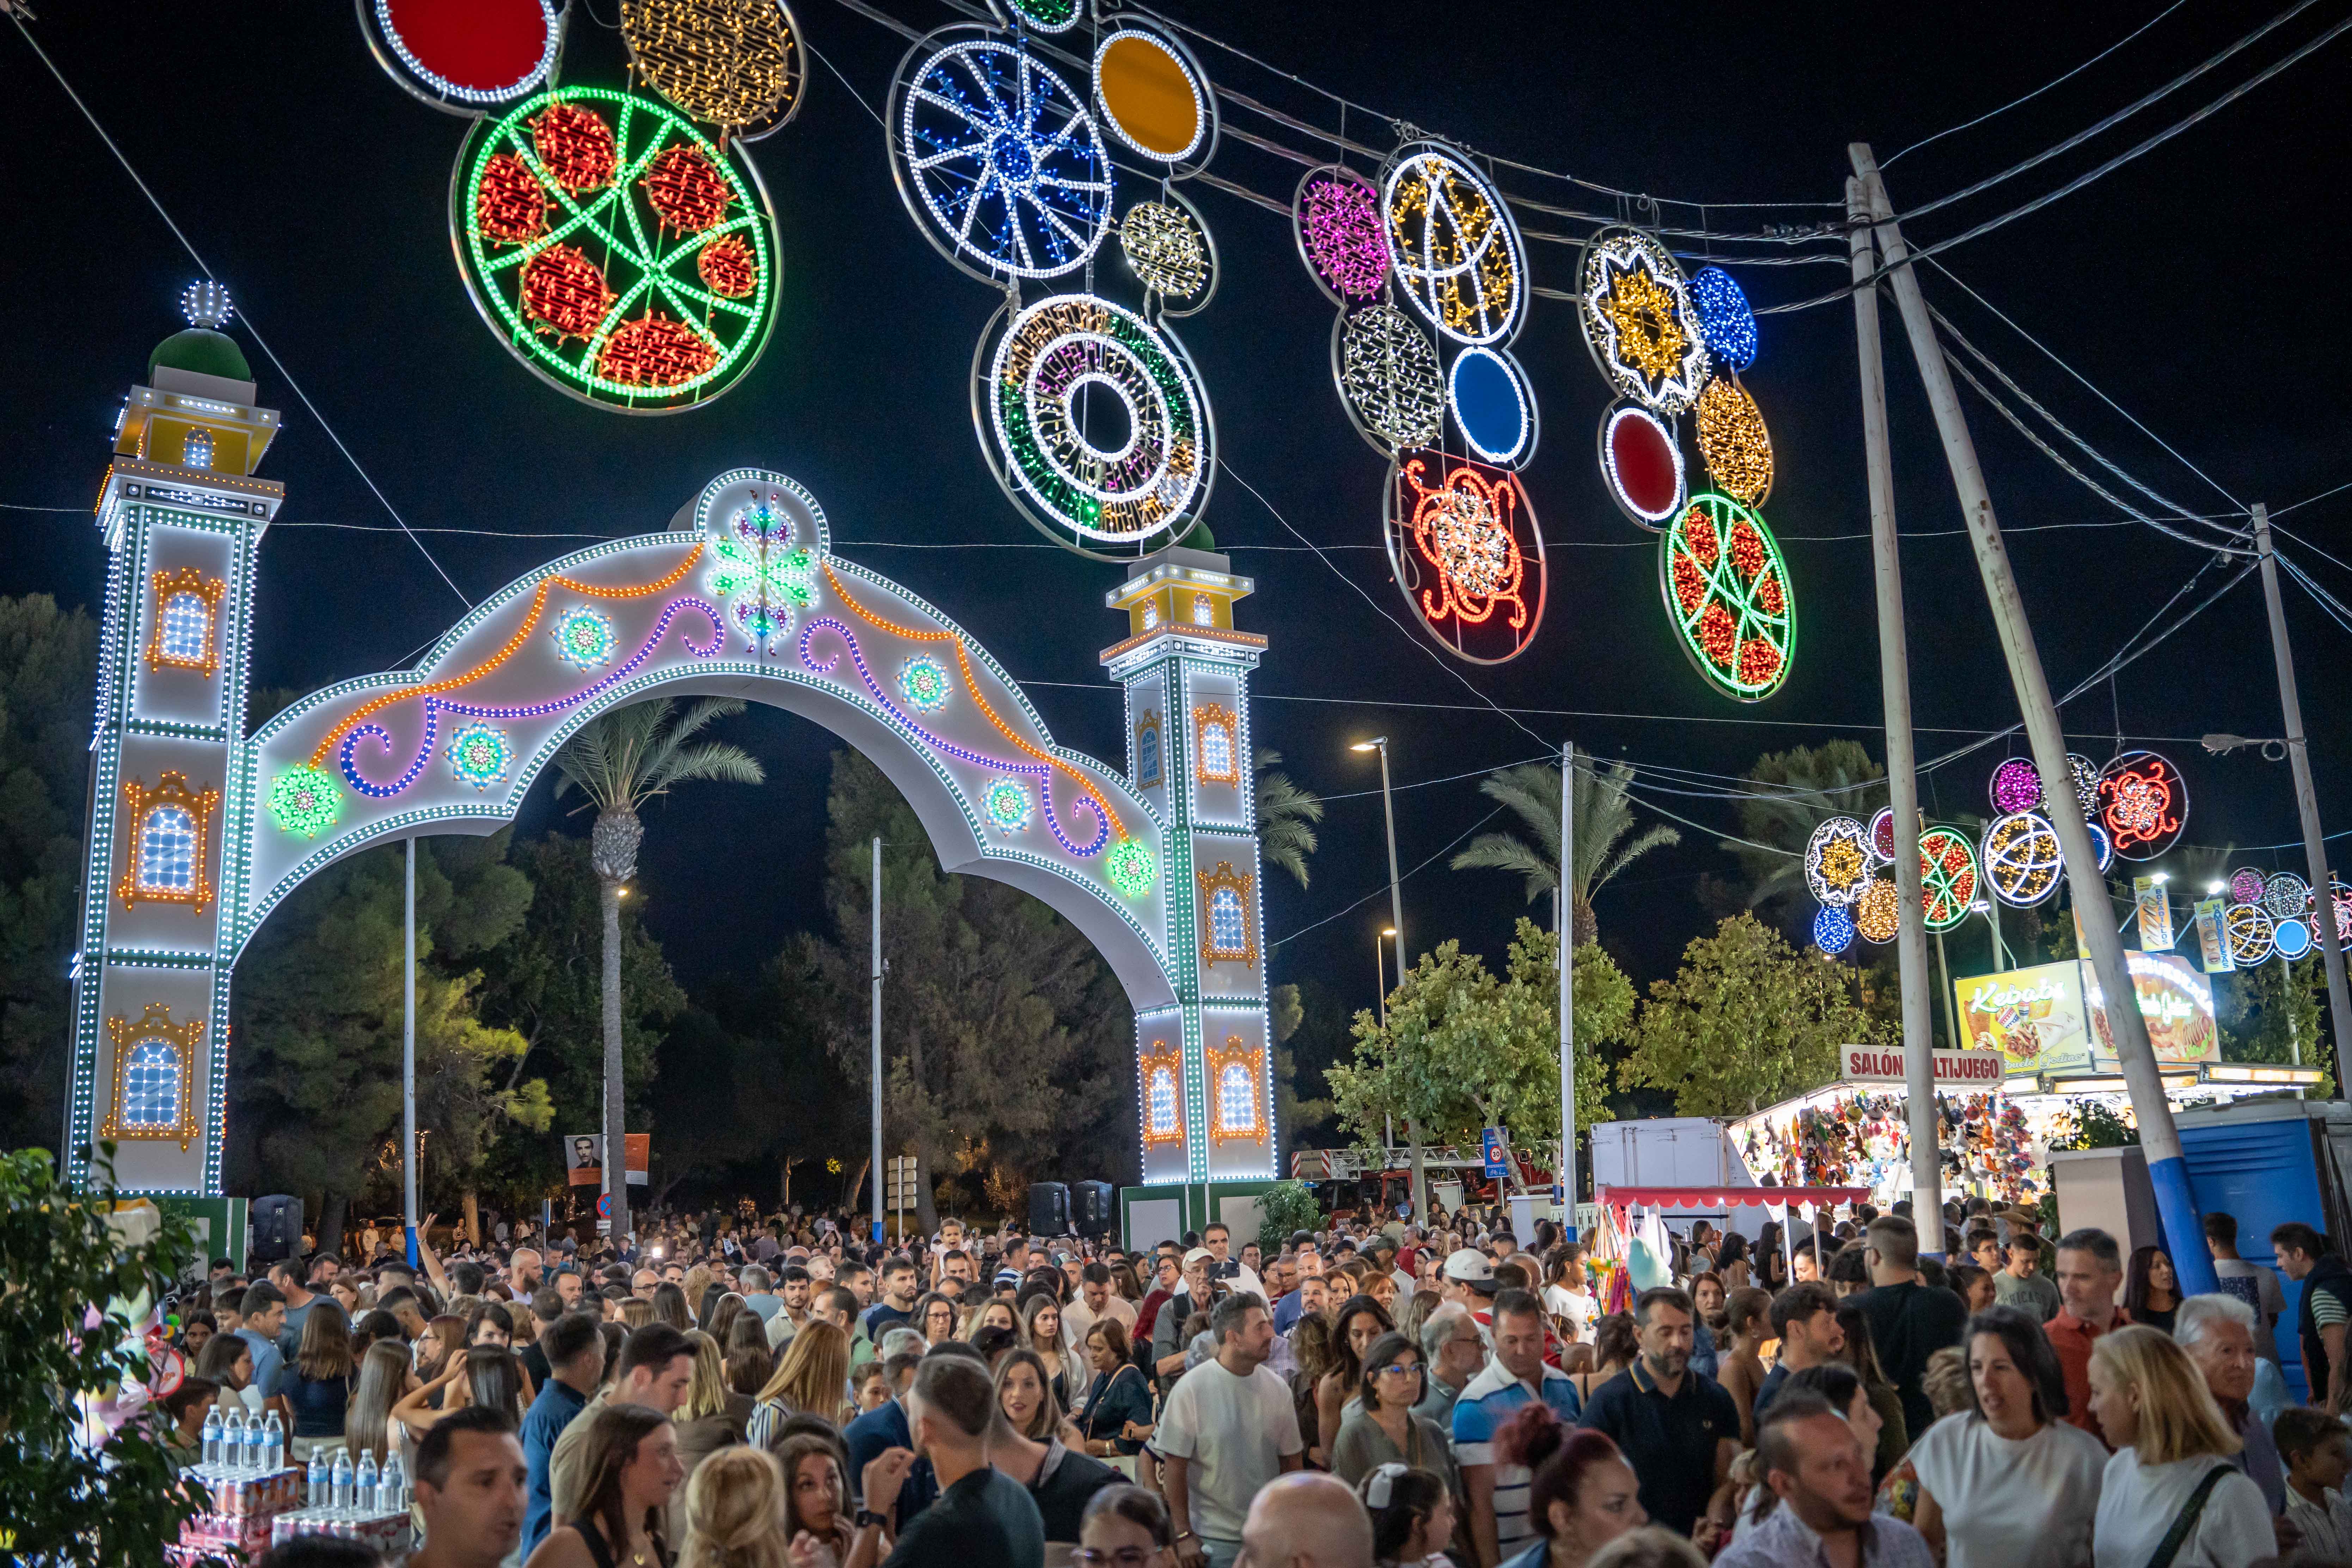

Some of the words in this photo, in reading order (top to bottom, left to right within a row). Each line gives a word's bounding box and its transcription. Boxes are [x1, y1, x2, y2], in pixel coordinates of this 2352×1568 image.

[2155, 889, 2168, 945] BOCADILLOS
[2212, 903, 2229, 968] HAMBURGUESAS
[1970, 978, 2065, 1014] Kebabs
[1850, 1048, 1903, 1077] SALÓN
[1933, 1057, 1999, 1079] LTIJUEGO
[2004, 1058, 2036, 1070] buelo
